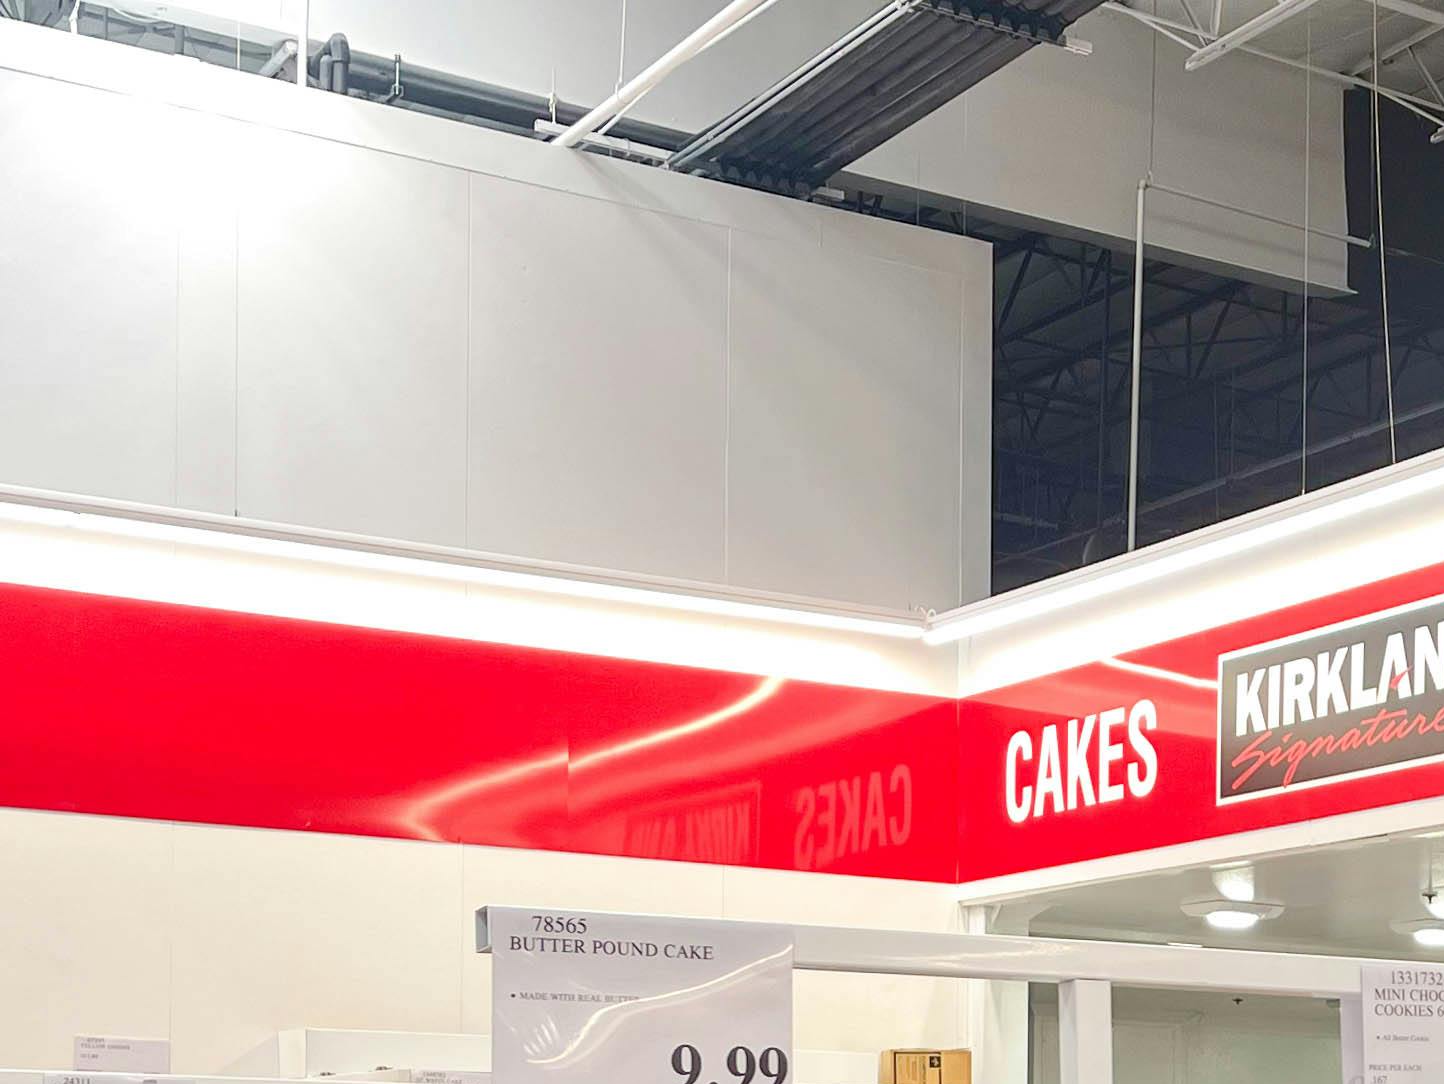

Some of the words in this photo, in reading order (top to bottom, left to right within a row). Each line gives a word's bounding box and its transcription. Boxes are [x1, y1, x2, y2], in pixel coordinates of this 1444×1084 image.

[1005, 697, 1159, 824] CAKES
[532, 915, 587, 934] 78565
[510, 936, 586, 953] BUTTER
[592, 939, 658, 957] POUND
[664, 943, 714, 960] CAKE
[1391, 971, 1443, 985] 1331732
[519, 992, 547, 1001] MADE
[551, 993, 575, 1001] WITH
[1374, 988, 1405, 1001] MINI
[1374, 1003, 1434, 1017] COOKIES
